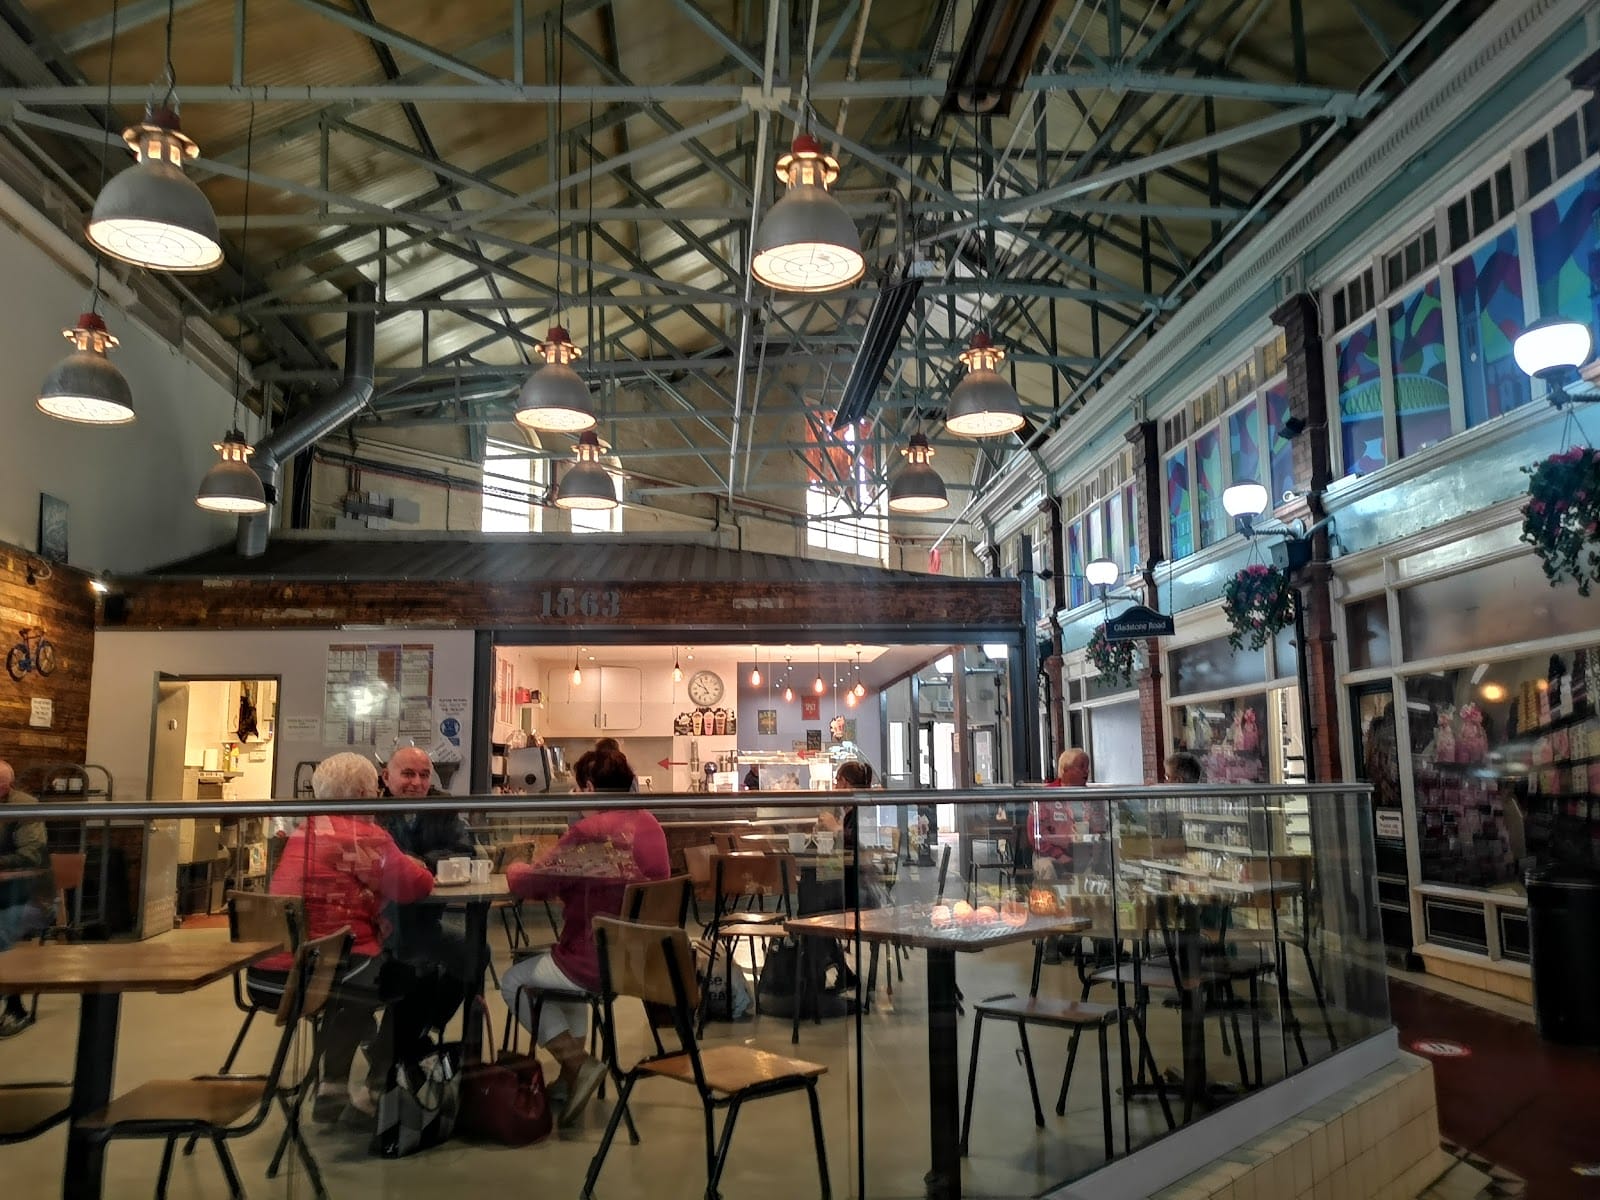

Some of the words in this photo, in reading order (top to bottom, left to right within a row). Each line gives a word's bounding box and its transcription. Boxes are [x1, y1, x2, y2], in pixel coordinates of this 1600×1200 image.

[540, 591, 620, 617] 1863
[1113, 622, 1147, 632] Gladstone
[1148, 621, 1166, 630] Road
